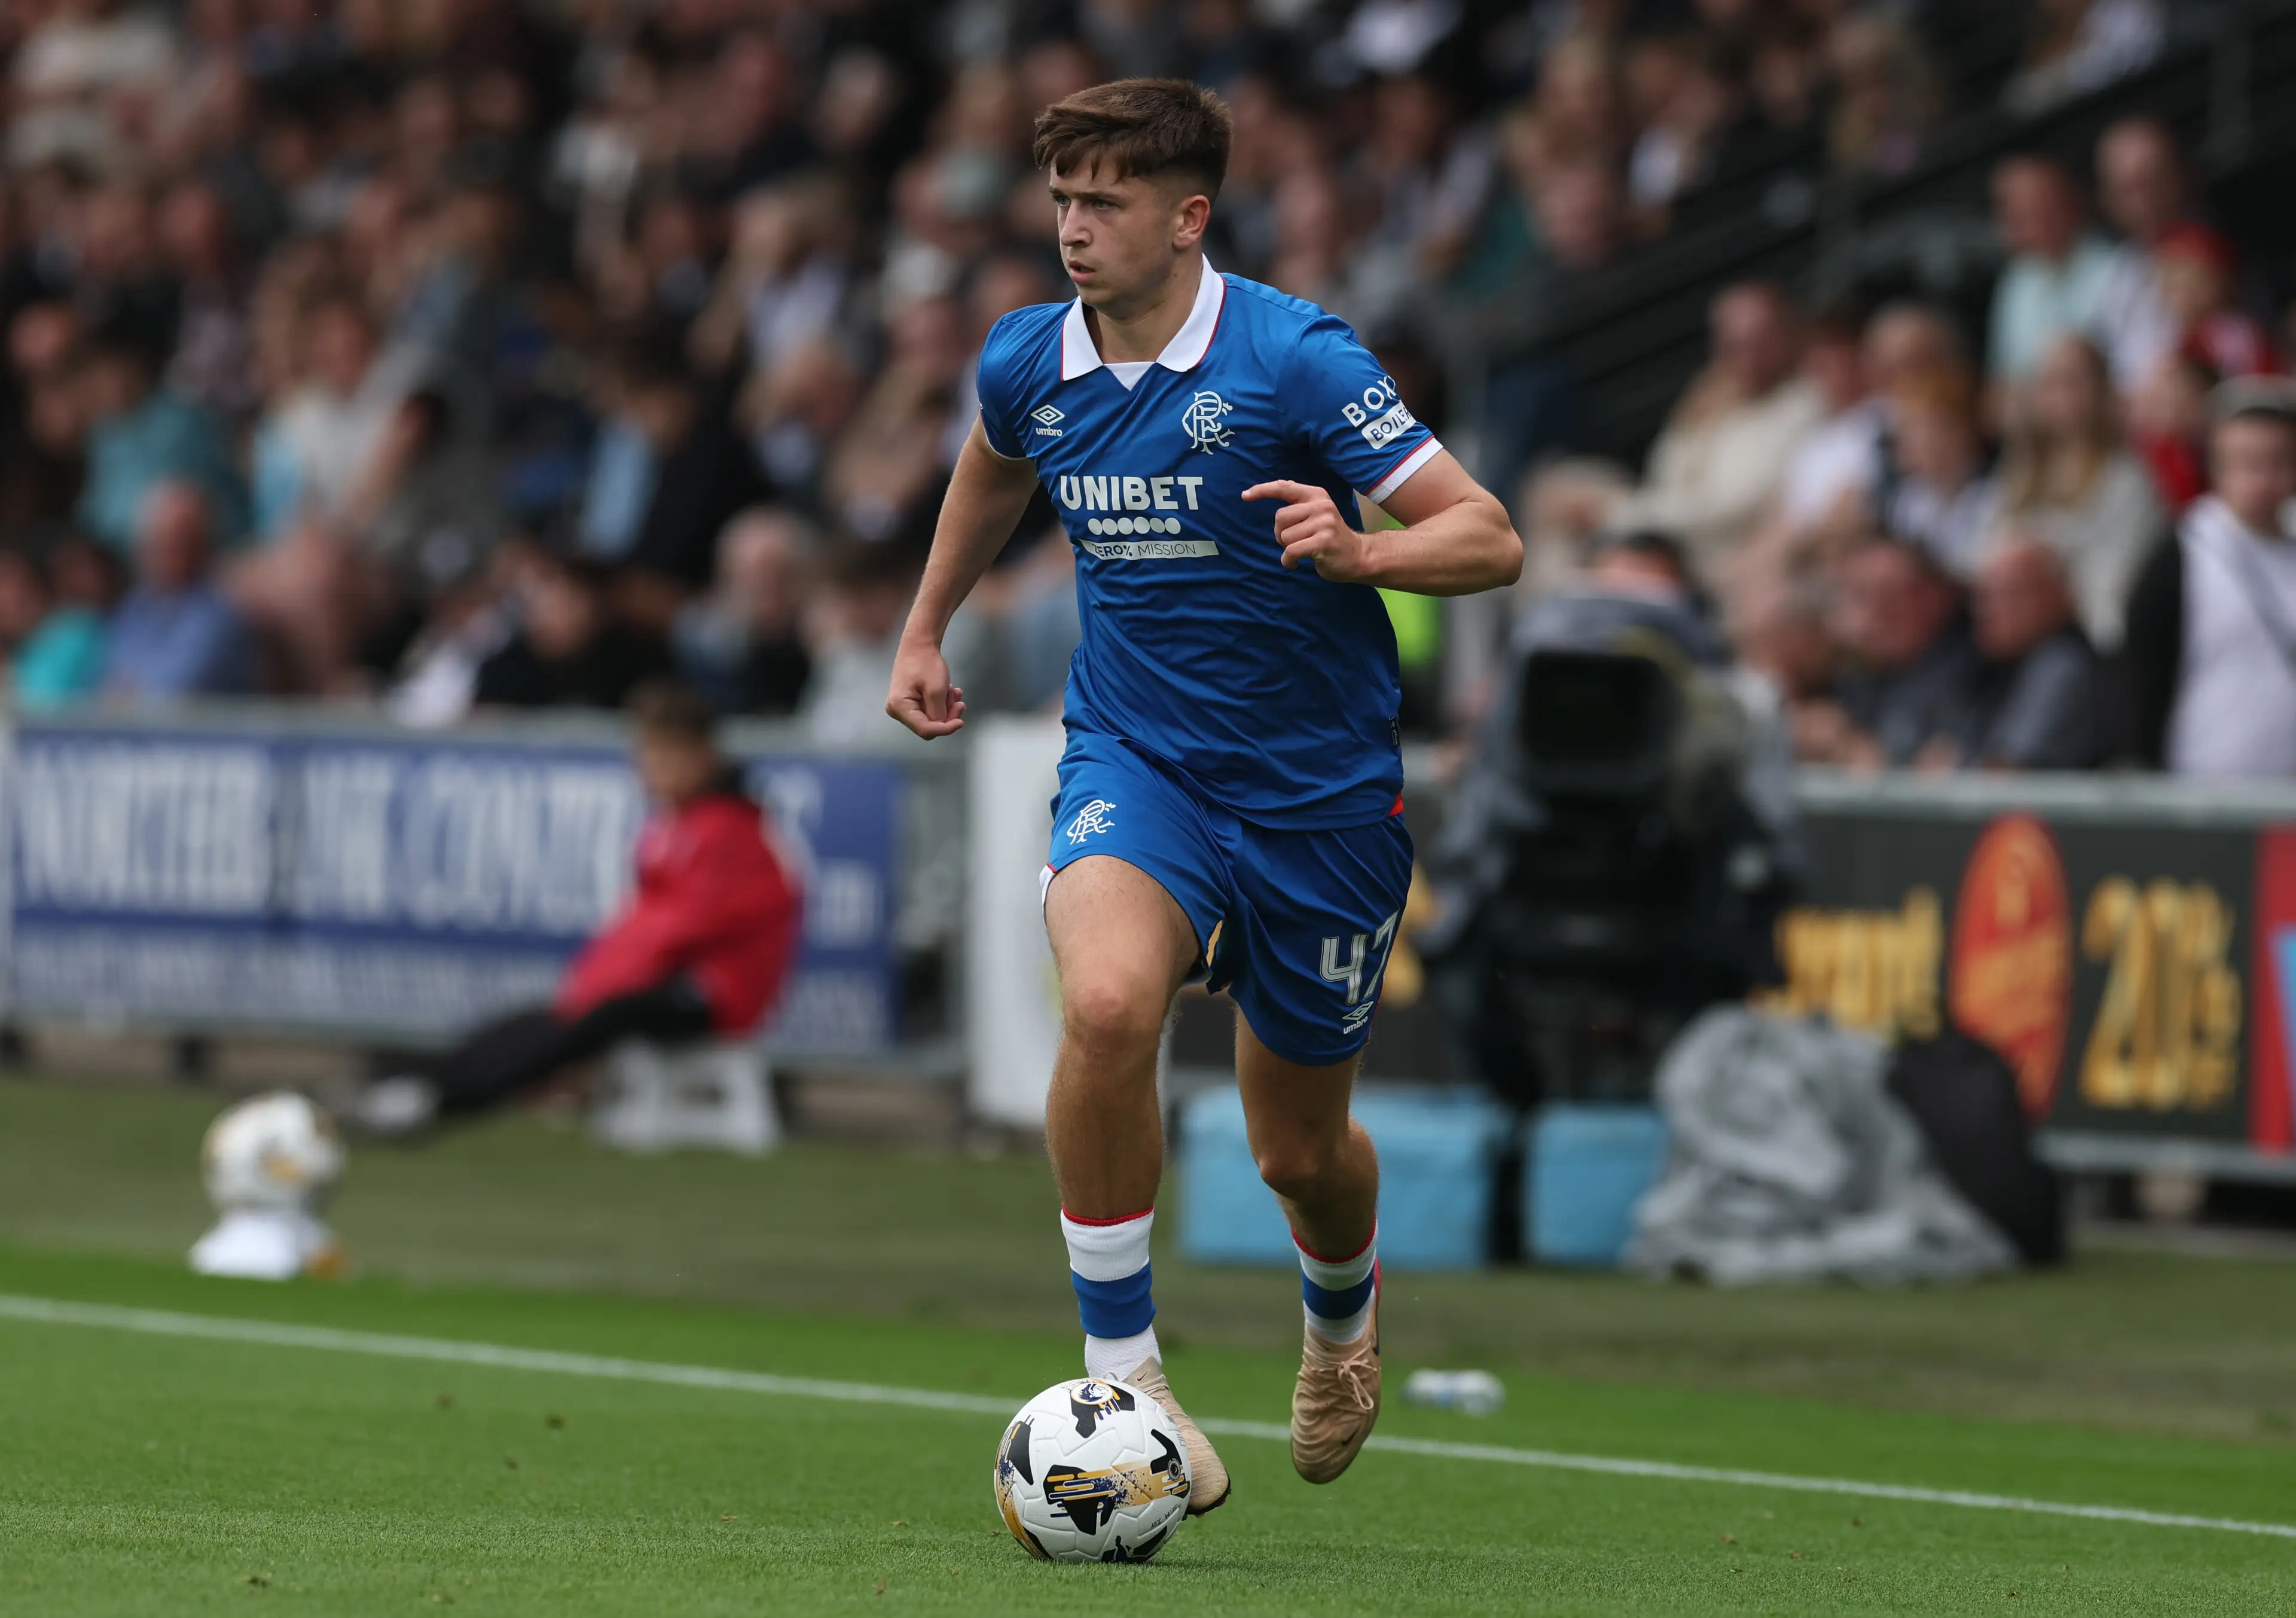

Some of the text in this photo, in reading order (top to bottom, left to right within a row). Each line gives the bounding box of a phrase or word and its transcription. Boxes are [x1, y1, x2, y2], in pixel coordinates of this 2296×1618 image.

[1036, 426, 1062, 436] umbro
[1060, 475, 1203, 511] UNIBET
[1137, 543, 1196, 556] MISSION
[1320, 909, 1400, 1006] 47
[1344, 1016, 1368, 1034] umbro
